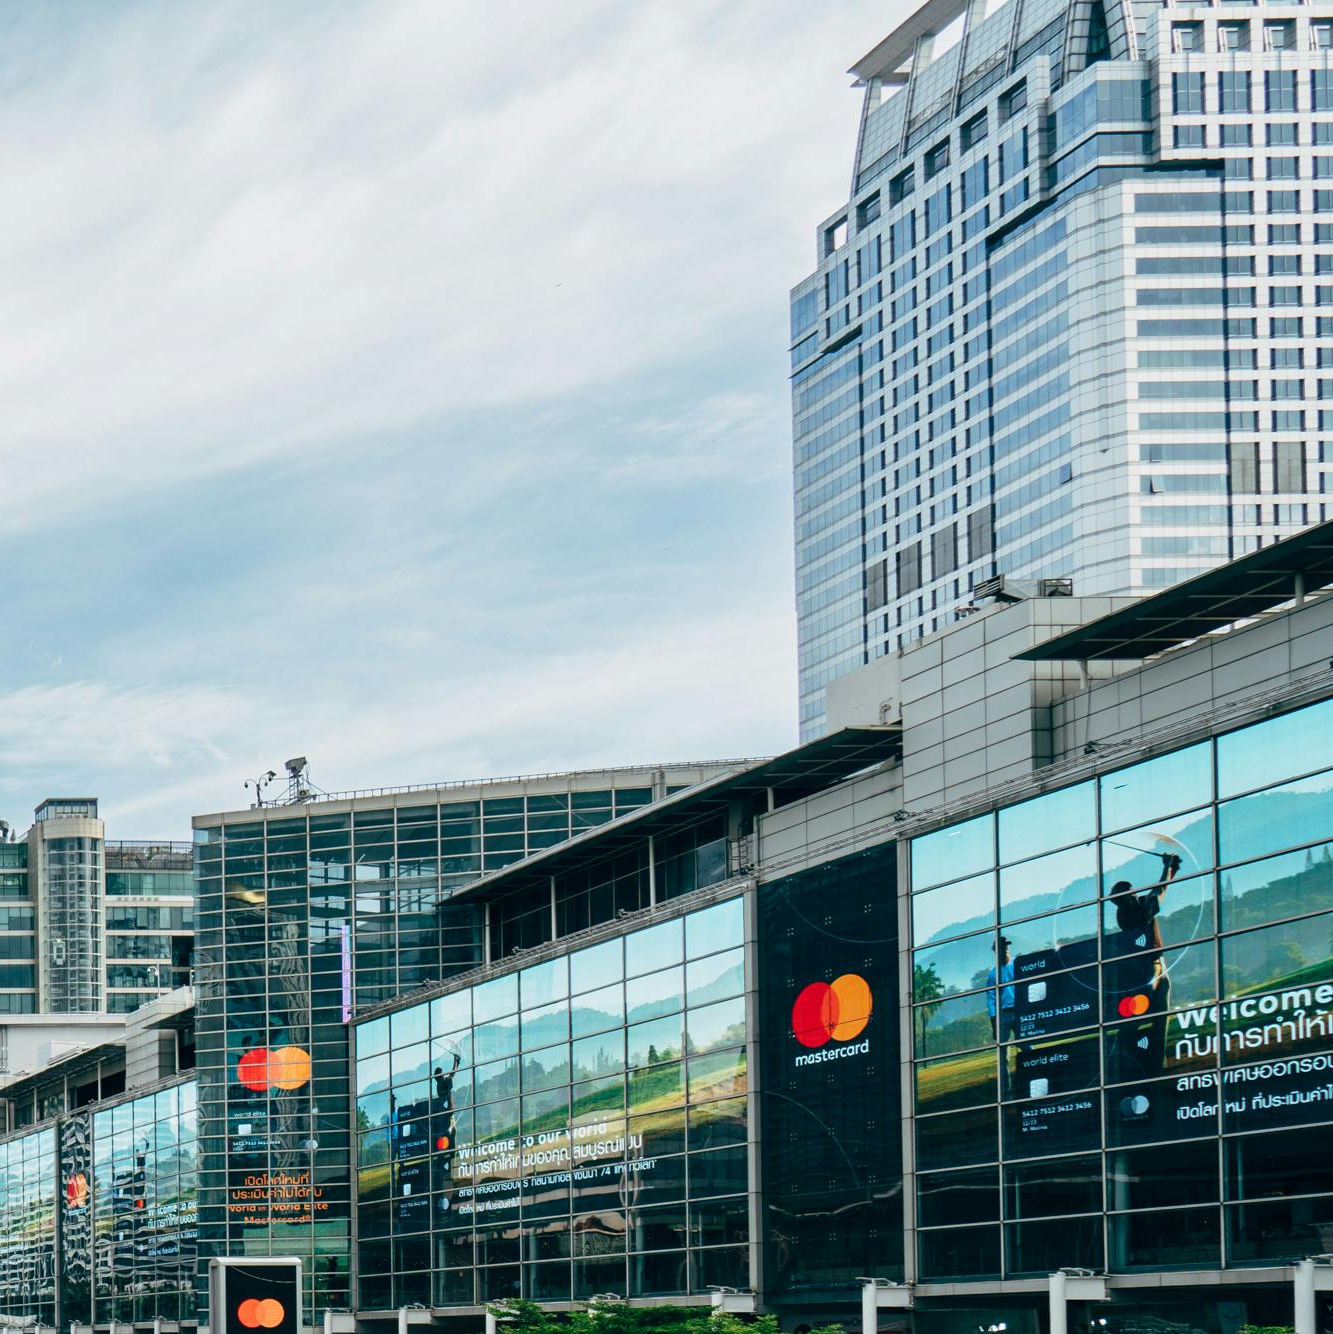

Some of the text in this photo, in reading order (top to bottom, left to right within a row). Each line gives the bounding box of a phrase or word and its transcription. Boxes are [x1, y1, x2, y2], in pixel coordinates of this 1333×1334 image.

[1021, 959, 1046, 972] world
[1175, 984, 1333, 1029] Welcome
[795, 1038, 871, 1068] mastercard
[1023, 1052, 1069, 1068] world elite
